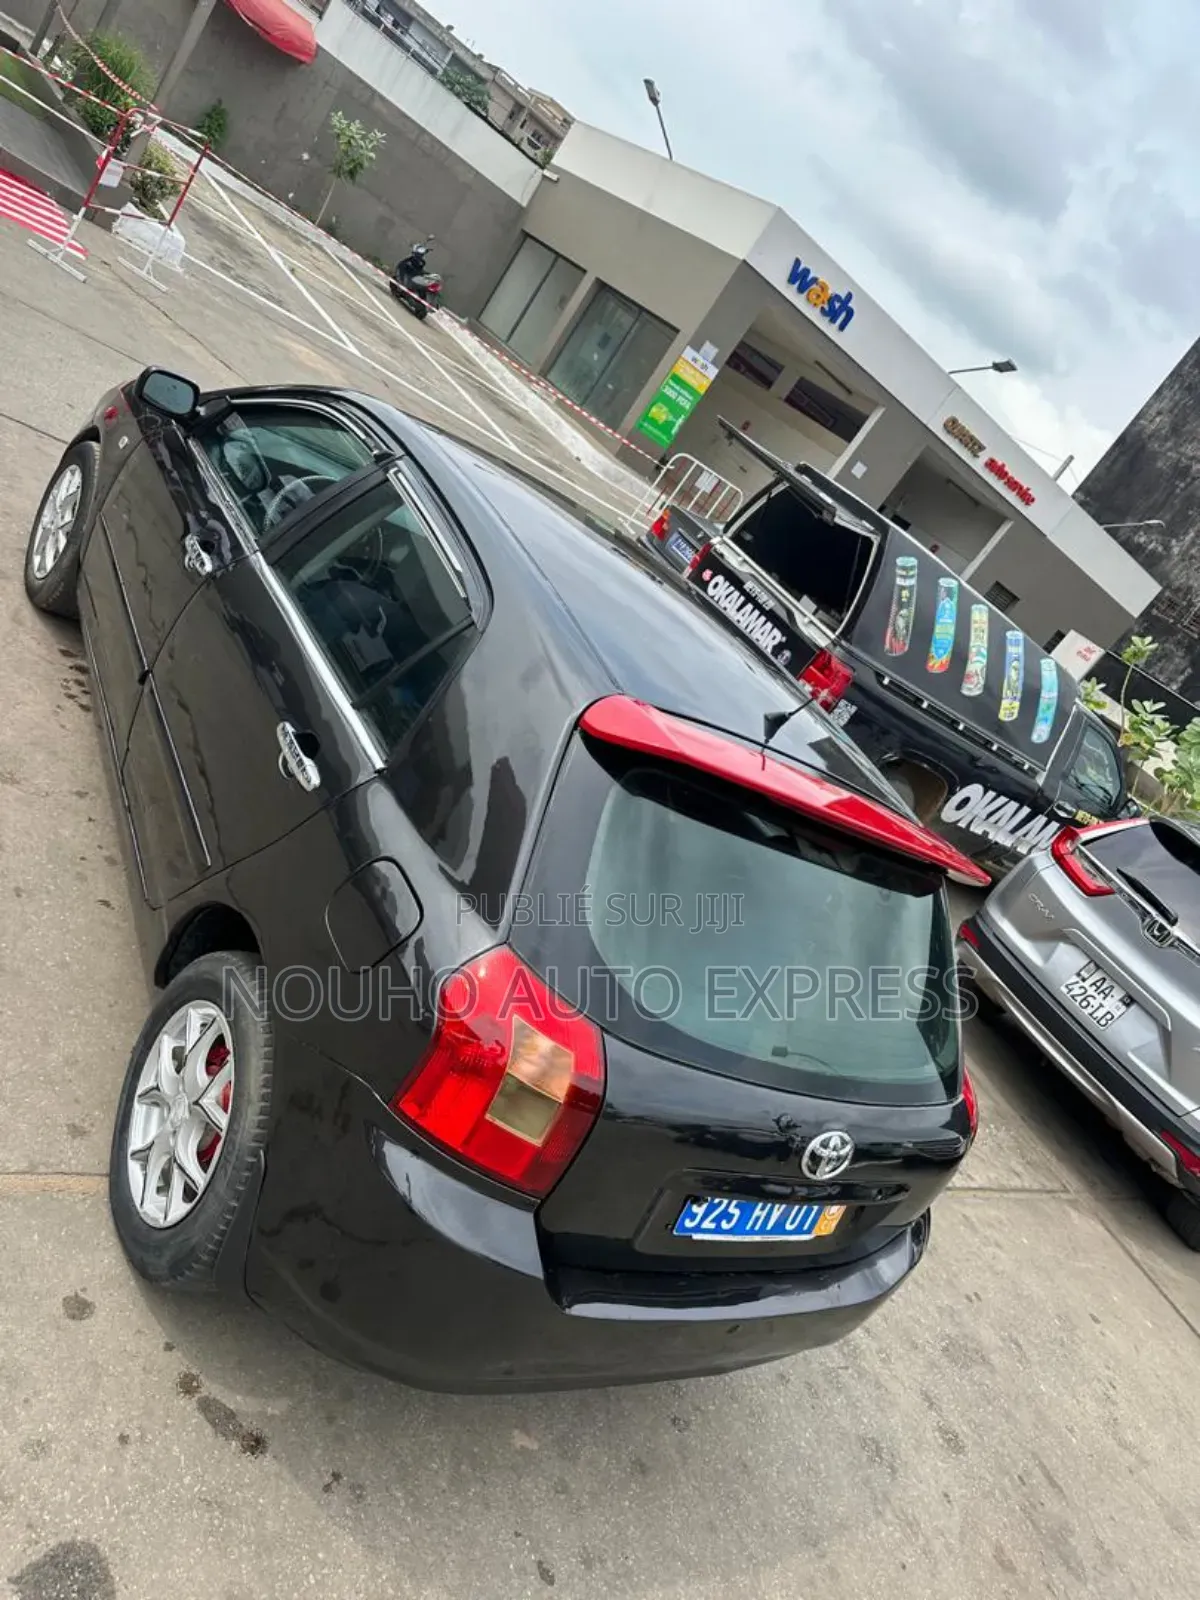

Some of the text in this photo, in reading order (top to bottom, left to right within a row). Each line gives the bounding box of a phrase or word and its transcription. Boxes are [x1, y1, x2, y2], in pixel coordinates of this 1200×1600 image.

[787, 257, 856, 332] wash
[706, 573, 784, 657] OKALAMAR
[745, 1203, 787, 1231] HV
